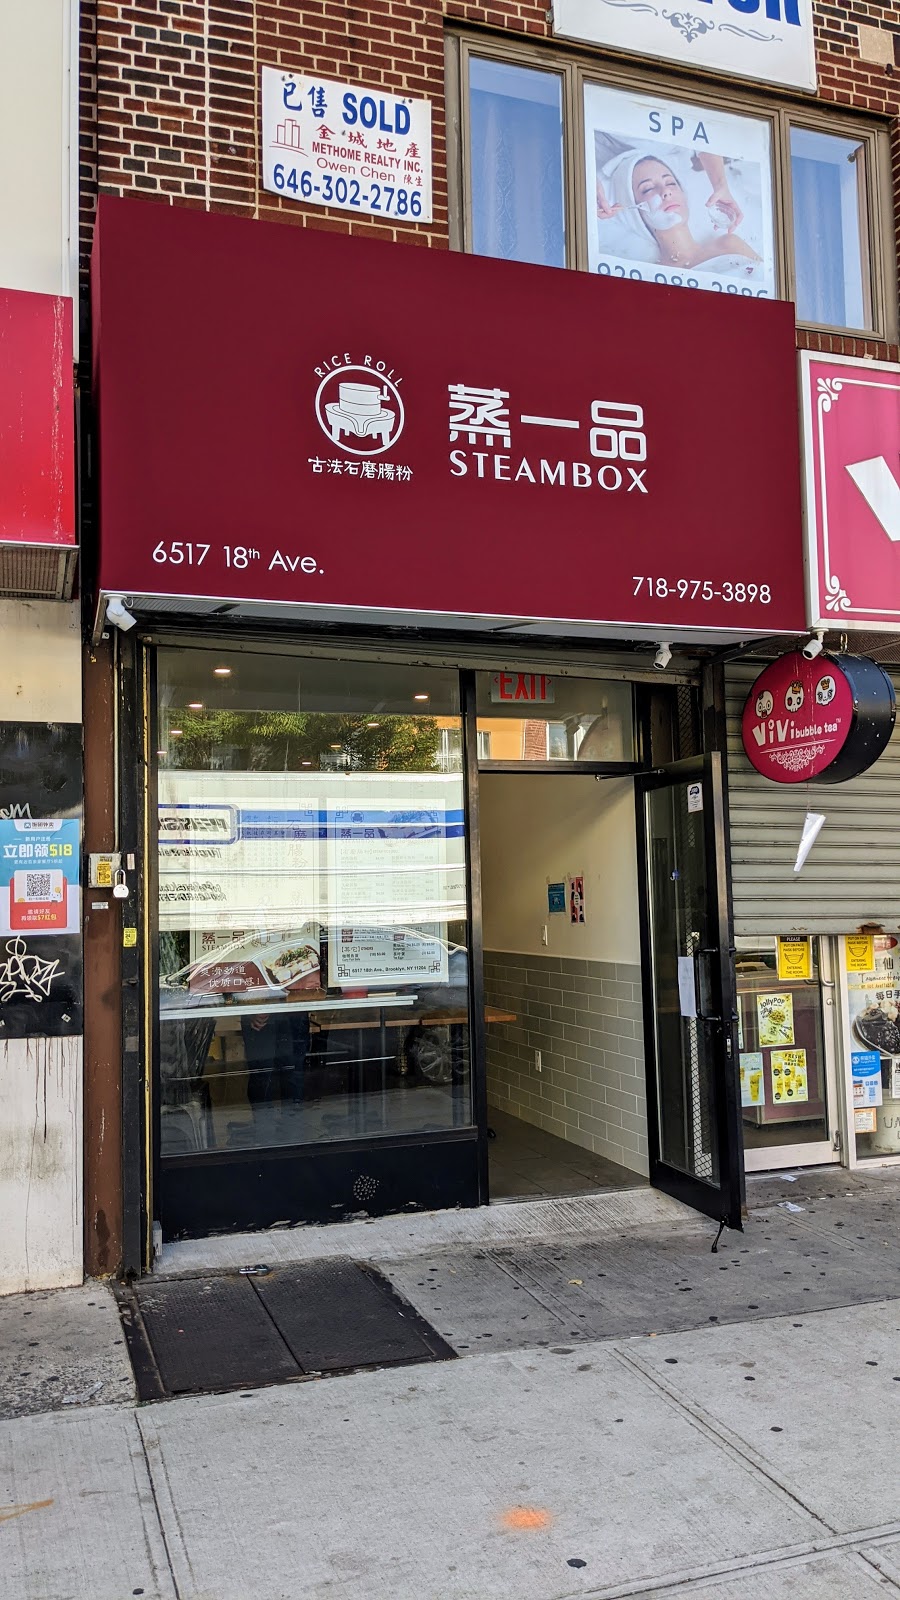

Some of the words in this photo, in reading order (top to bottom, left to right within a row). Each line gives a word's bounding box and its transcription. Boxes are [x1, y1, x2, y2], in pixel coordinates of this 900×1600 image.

[342, 92, 411, 135] SOLD
[648, 111, 710, 145] SPA
[312, 141, 361, 161] METHOME
[364, 152, 401, 169] REALTY
[403, 160, 424, 173] INC.
[315, 124, 422, 159] 金城地產
[316, 157, 356, 174] Owen
[360, 166, 396, 182] Chen
[273, 163, 422, 217] 646-302-2786
[314, 353, 352, 378] RICE
[364, 355, 403, 388] ROLL
[447, 383, 647, 462] 蒸一品
[307, 455, 414, 482] 古法石磨腸粉
[450, 450, 649, 494] STEAMBOX
[152, 540, 211, 566] 6517
[223, 545, 261, 569] 18th
[268, 549, 325, 575] Ave.
[632, 576, 772, 604] 718-975-3898
[499, 671, 546, 700] EXIT
[795, 723, 822, 738] bubble
[824, 722, 838, 733] tea
[202, 930, 245, 945] 蒸一品
